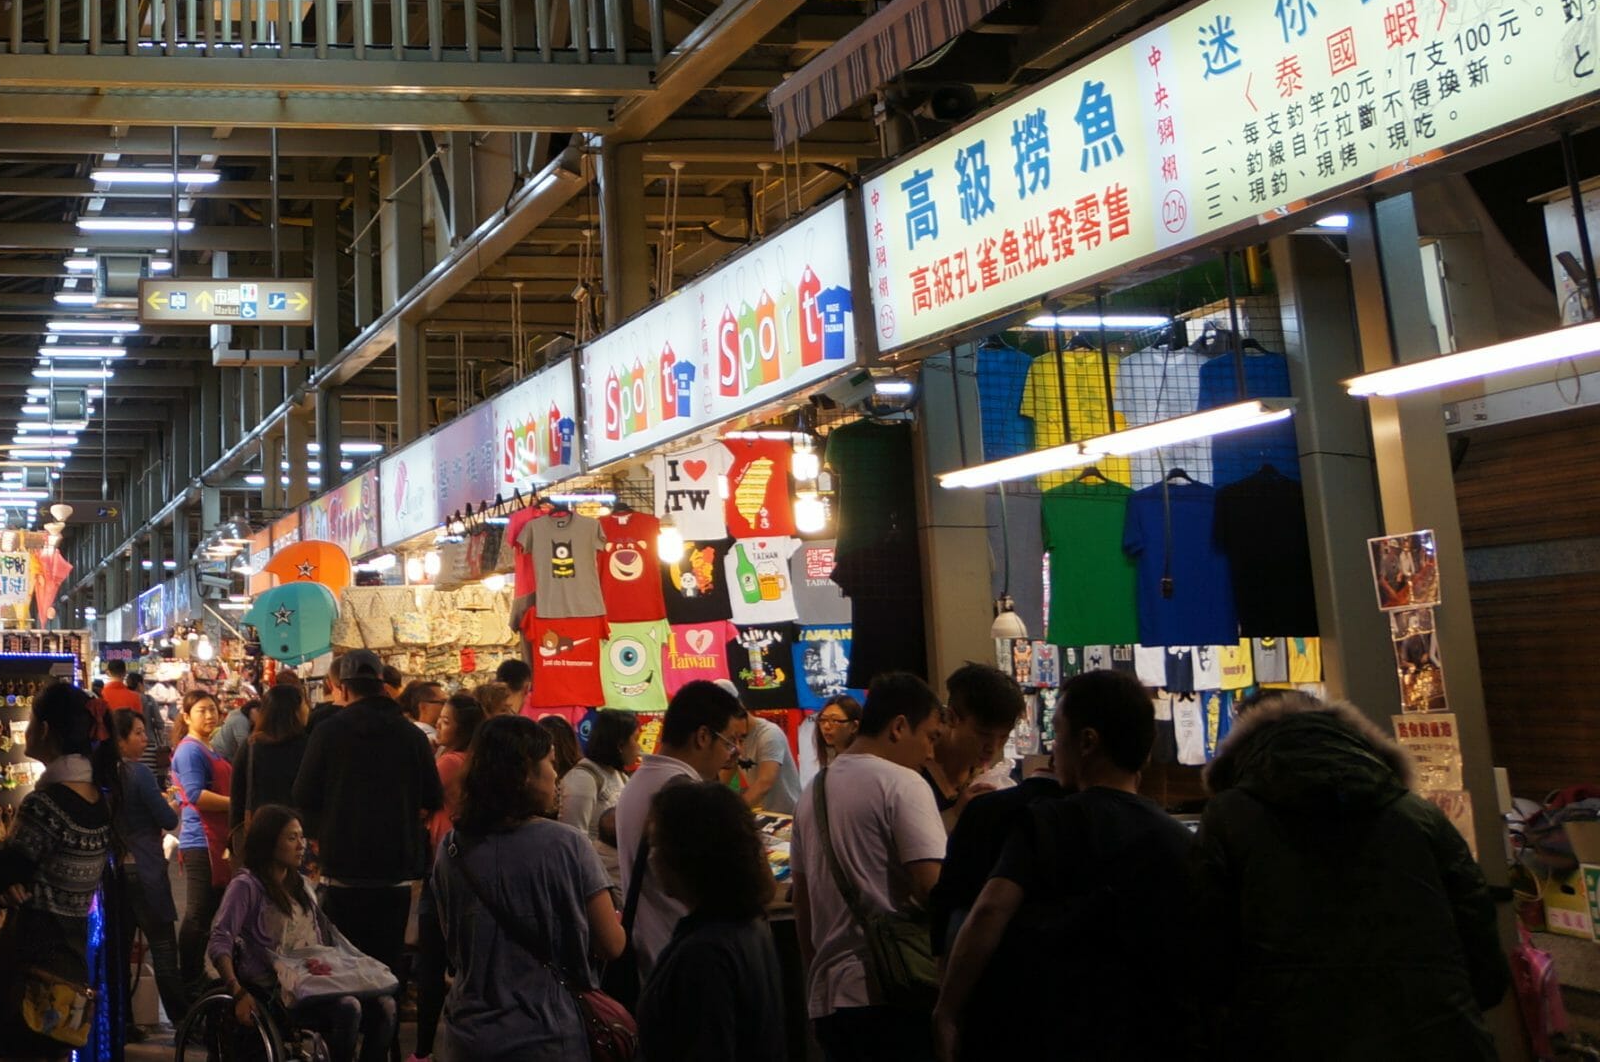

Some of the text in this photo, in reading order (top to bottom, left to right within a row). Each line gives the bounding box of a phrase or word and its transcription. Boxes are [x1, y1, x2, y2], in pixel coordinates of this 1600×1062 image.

[900, 79, 1125, 251] 高級撈魚
[1163, 198, 1187, 229] 226
[908, 181, 1131, 317] 高級孔雀魚批發零售
[214, 305, 240, 315] Market
[720, 291, 818, 395] Sport
[667, 459, 681, 482] I
[667, 489, 710, 512] TW
[752, 551, 779, 559] TAIWAN
[668, 652, 717, 670] Taiwan
